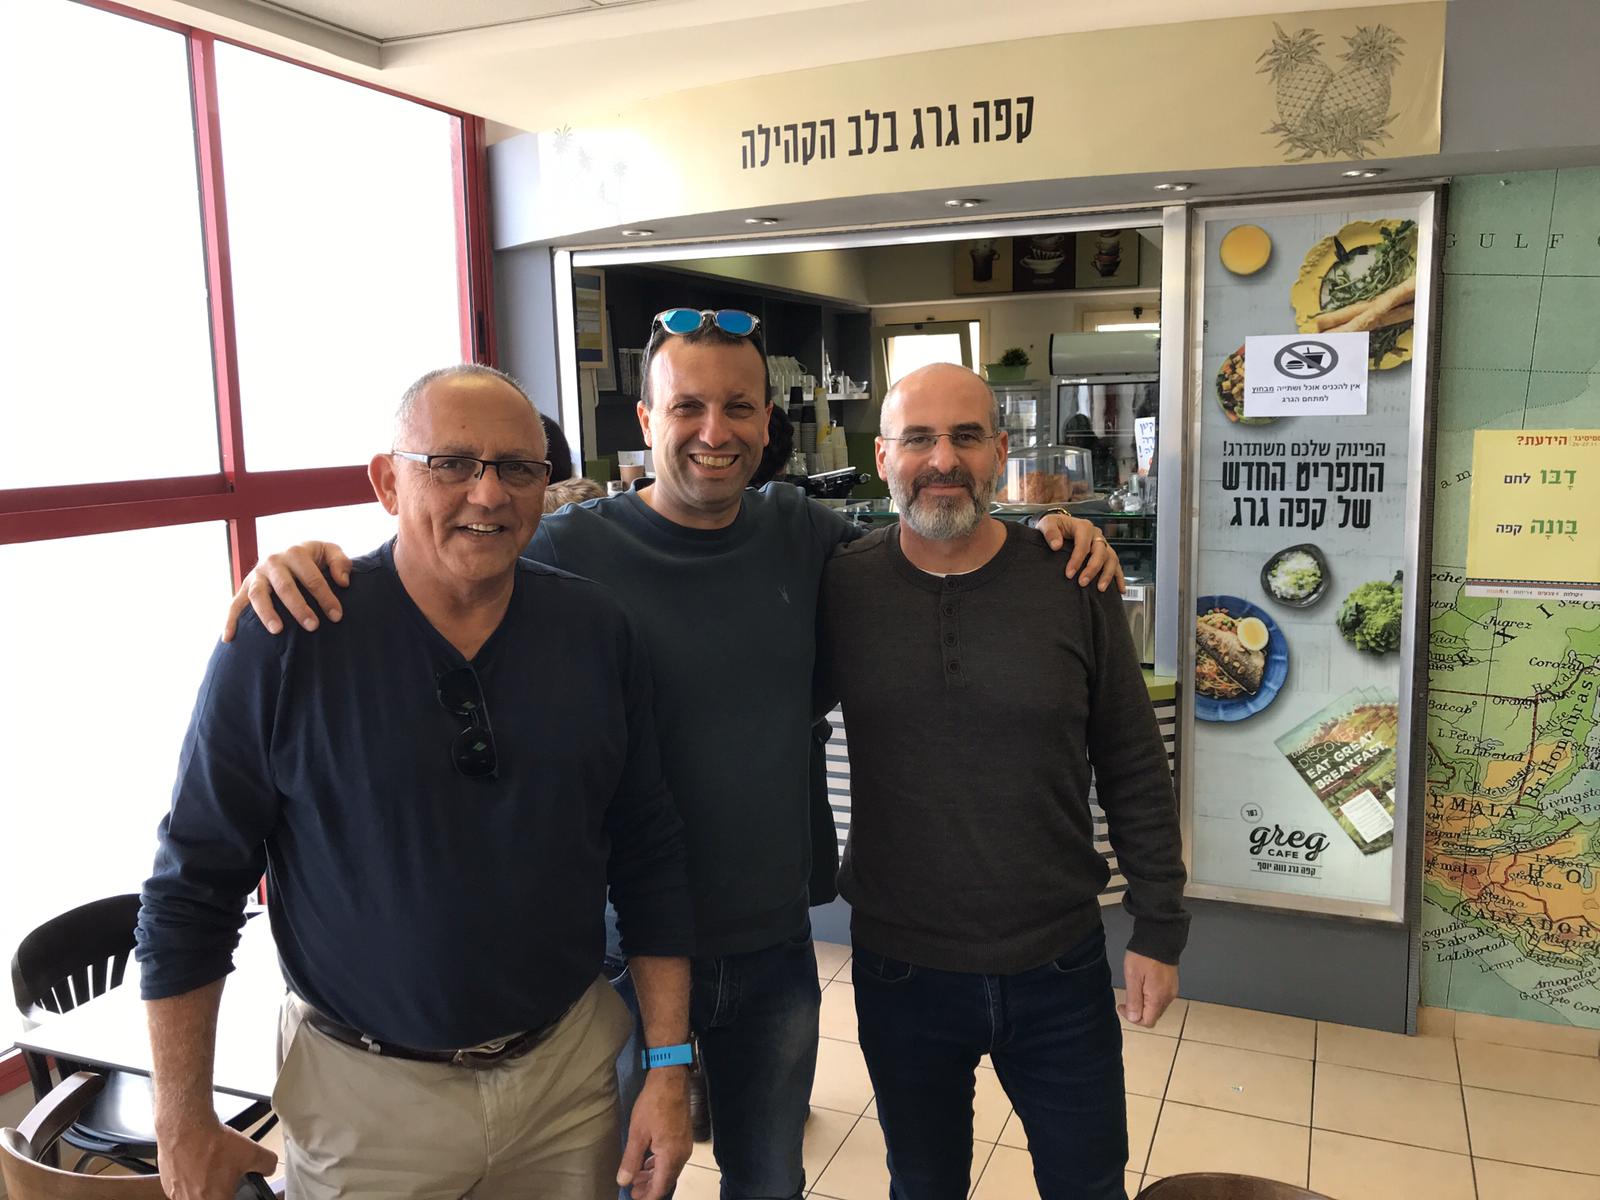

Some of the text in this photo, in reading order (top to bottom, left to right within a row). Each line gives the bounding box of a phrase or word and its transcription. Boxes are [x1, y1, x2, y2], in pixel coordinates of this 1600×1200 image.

[741, 96, 1035, 170] קפה גרג בלב הקהילה
[1252, 385, 1275, 394] מבחוץ
[1303, 383, 1320, 391] אוכל
[1322, 382, 1348, 391] להכניס
[1350, 383, 1361, 392] אין
[1302, 395, 1329, 403] למתחם
[1516, 435, 1568, 447] הידעת?
[1223, 440, 1386, 460] הפינוק שלכם משתדרג!
[1222, 461, 1385, 493] התפריט החדש
[1503, 473, 1531, 485] לחם
[1230, 495, 1371, 531] של קפה גרג
[1495, 523, 1523, 536] קפה
[1305, 758, 1331, 780] EAT
[1333, 730, 1375, 762] GREAT
[1249, 823, 1330, 862] greg
[1267, 848, 1299, 859] CAFE
[1288, 865, 1299, 873] גרג
[1301, 866, 1316, 877] קפה
